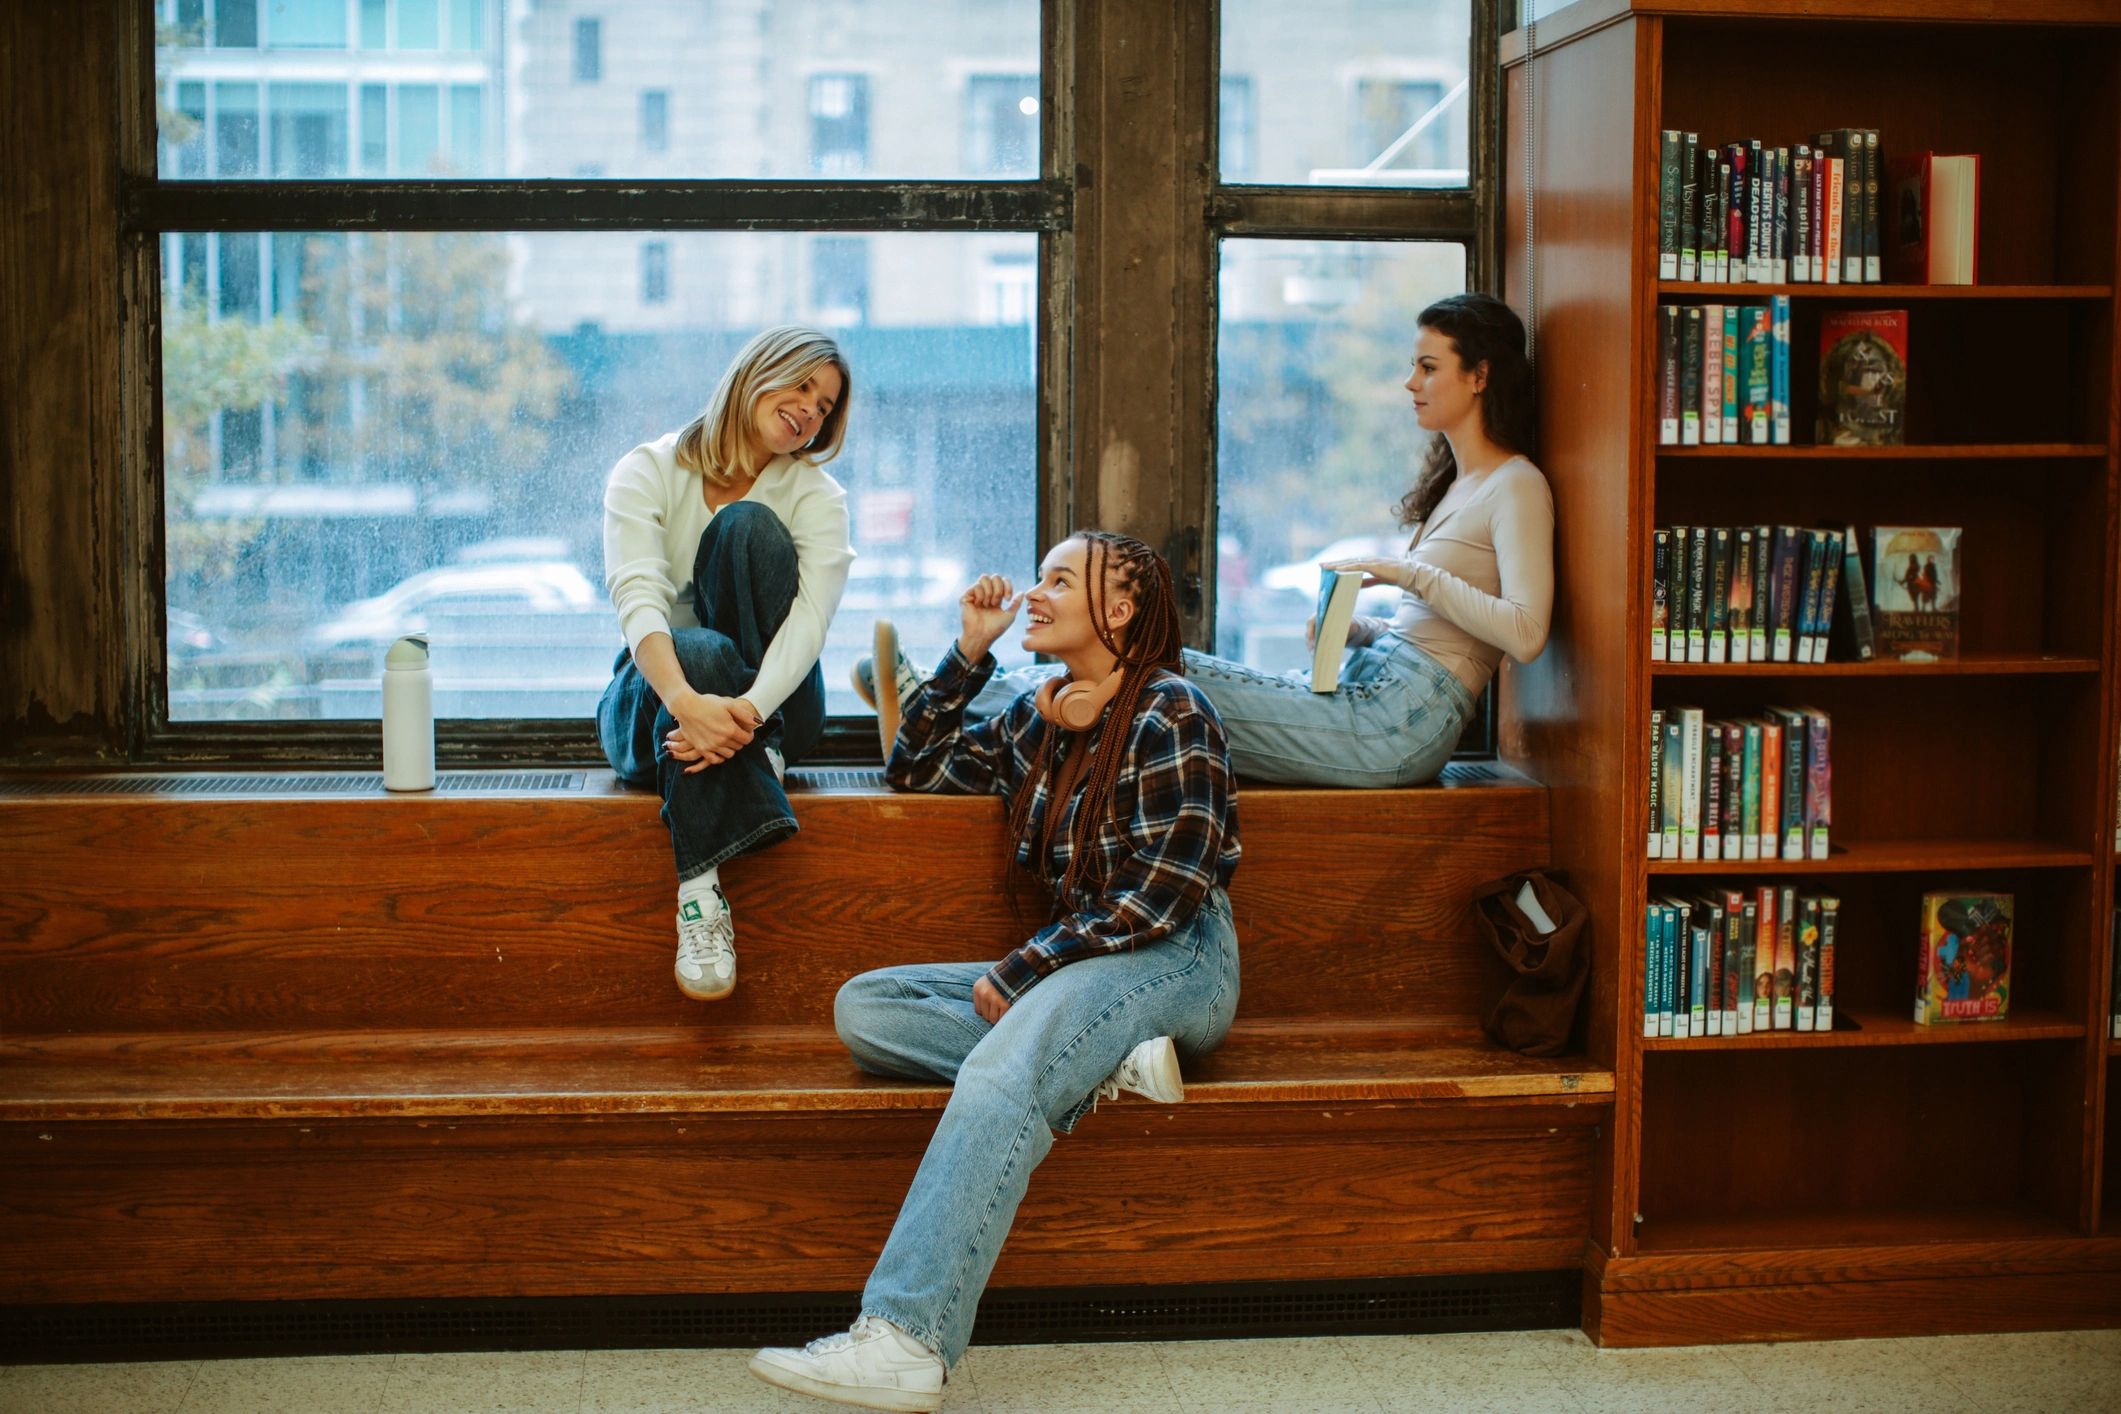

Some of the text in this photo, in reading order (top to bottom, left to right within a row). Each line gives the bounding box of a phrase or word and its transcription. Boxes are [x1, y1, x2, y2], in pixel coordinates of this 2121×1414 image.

[1762, 181, 1774, 219] DEATH'S
[1830, 173, 1842, 259] friends like thes
[1761, 221, 1772, 258] COUNTR
[1708, 327, 1722, 418] REBEL SPY
[1666, 387, 1675, 419] BLOND
[1651, 725, 1659, 742] FAR
[1650, 745, 1659, 778] WILDER
[1690, 753, 1698, 800] ENCHANTMENT
[1710, 756, 1721, 774] ONE
[1650, 781, 1658, 807] MAGIC
[1709, 777, 1720, 800] LAST
[1708, 802, 1719, 826] BREA
[1943, 1000, 1998, 1017] TRUTH IS
